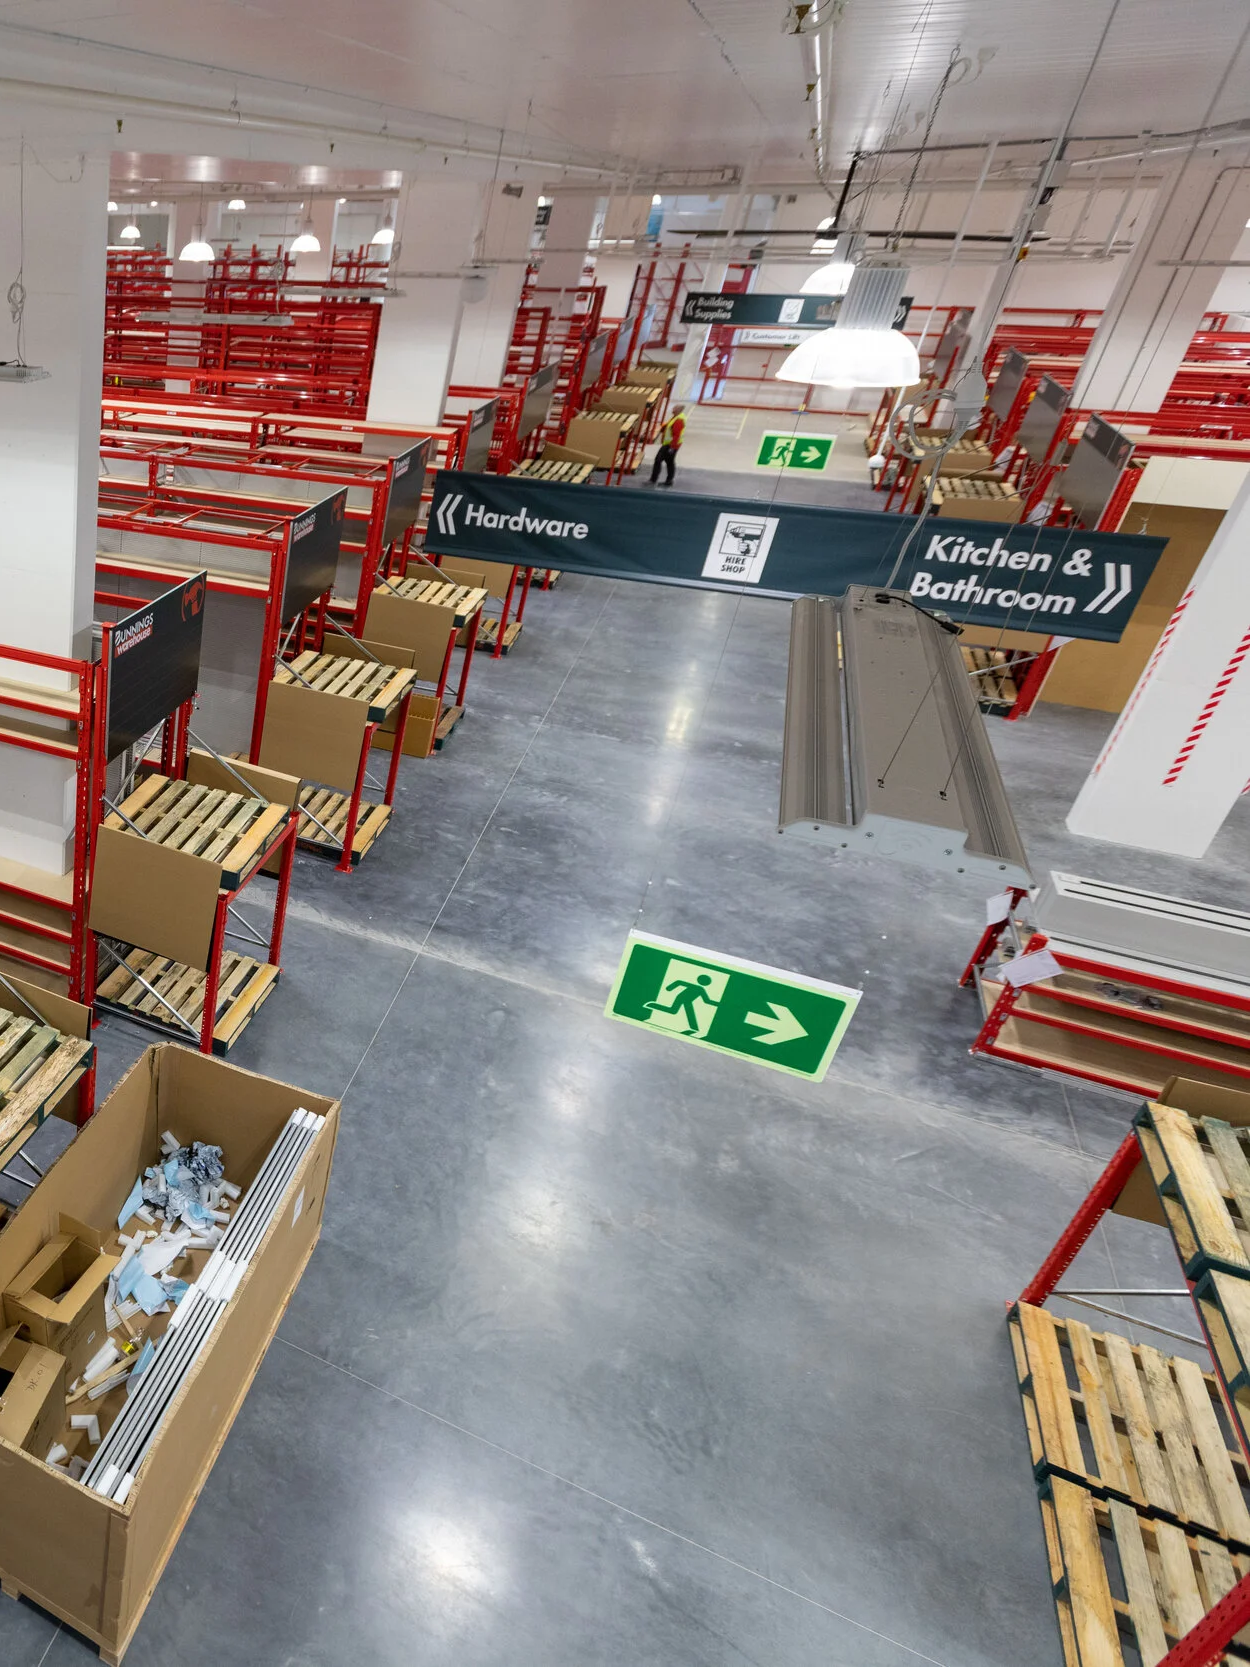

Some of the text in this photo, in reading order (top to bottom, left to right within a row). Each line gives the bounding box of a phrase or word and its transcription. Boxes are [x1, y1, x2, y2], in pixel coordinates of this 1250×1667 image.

[694, 308, 732, 321] Supplies
[697, 296, 735, 310] Building
[465, 503, 589, 540] Hardware
[720, 564, 746, 574] SHOP
[725, 555, 747, 565] HIRE
[924, 534, 1094, 577] Kitchen &
[909, 572, 1077, 615] Bathroom
[115, 612, 154, 647] BUNNINGS
[117, 627, 152, 656] warehouse
